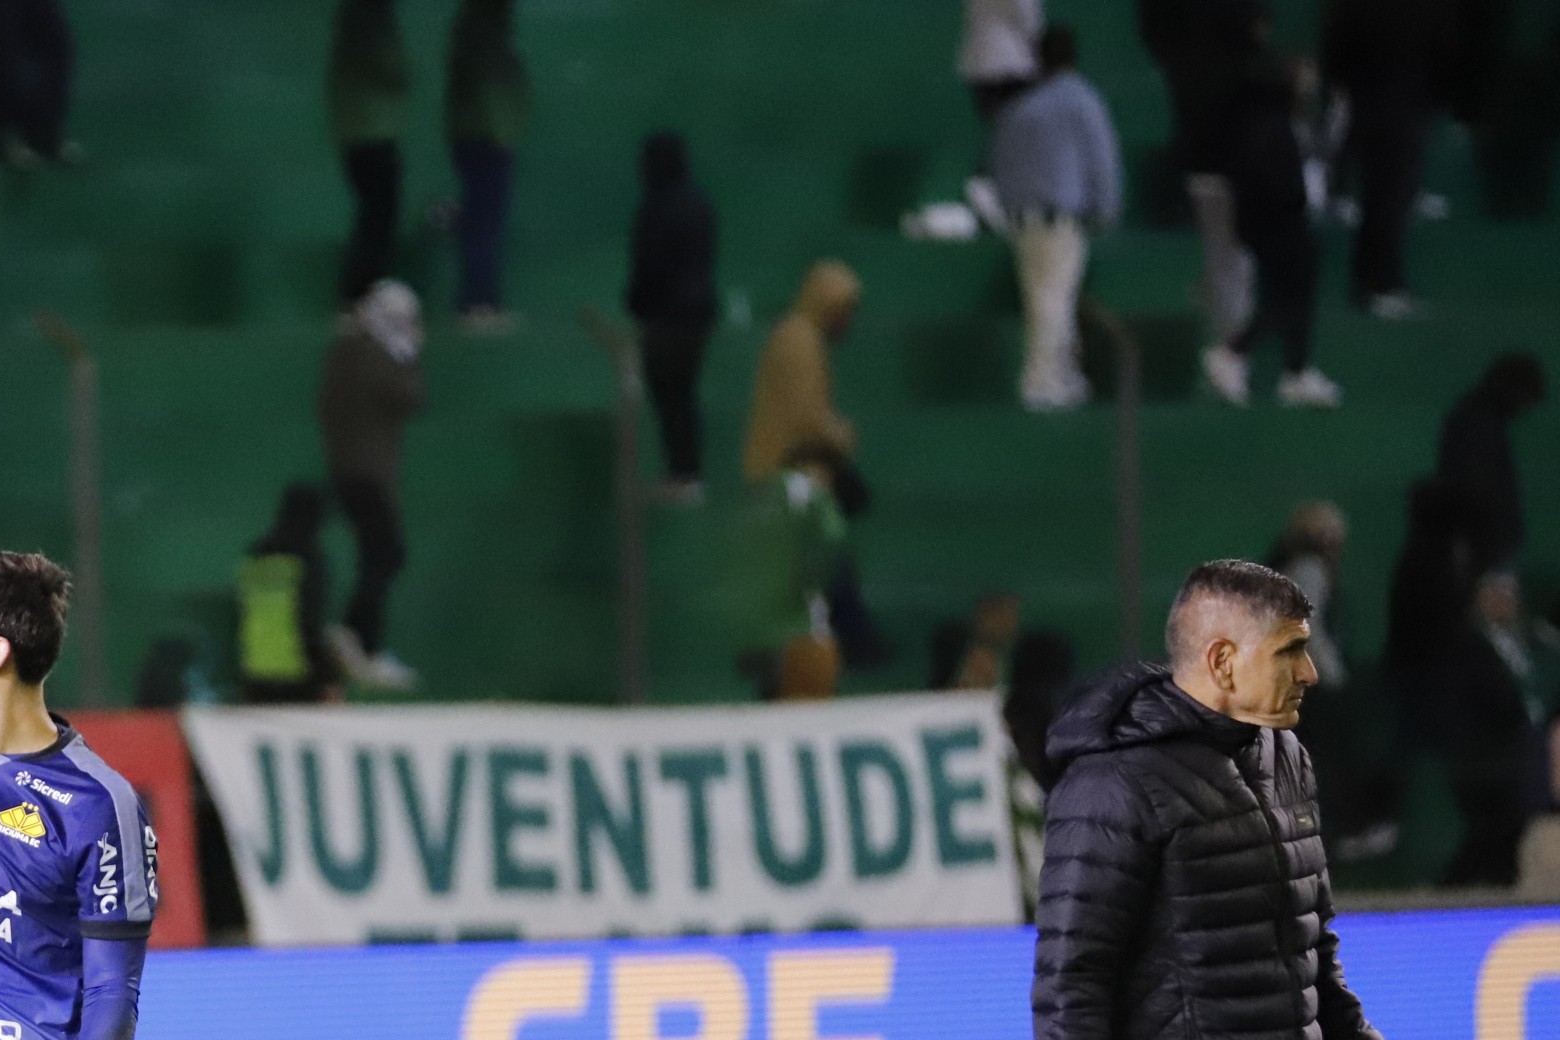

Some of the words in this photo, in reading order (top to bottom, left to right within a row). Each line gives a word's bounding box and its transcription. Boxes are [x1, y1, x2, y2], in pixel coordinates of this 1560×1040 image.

[30, 778, 73, 805] Sicredi
[247, 721, 999, 896] JUVENTUDE
[29, 838, 41, 848] EC
